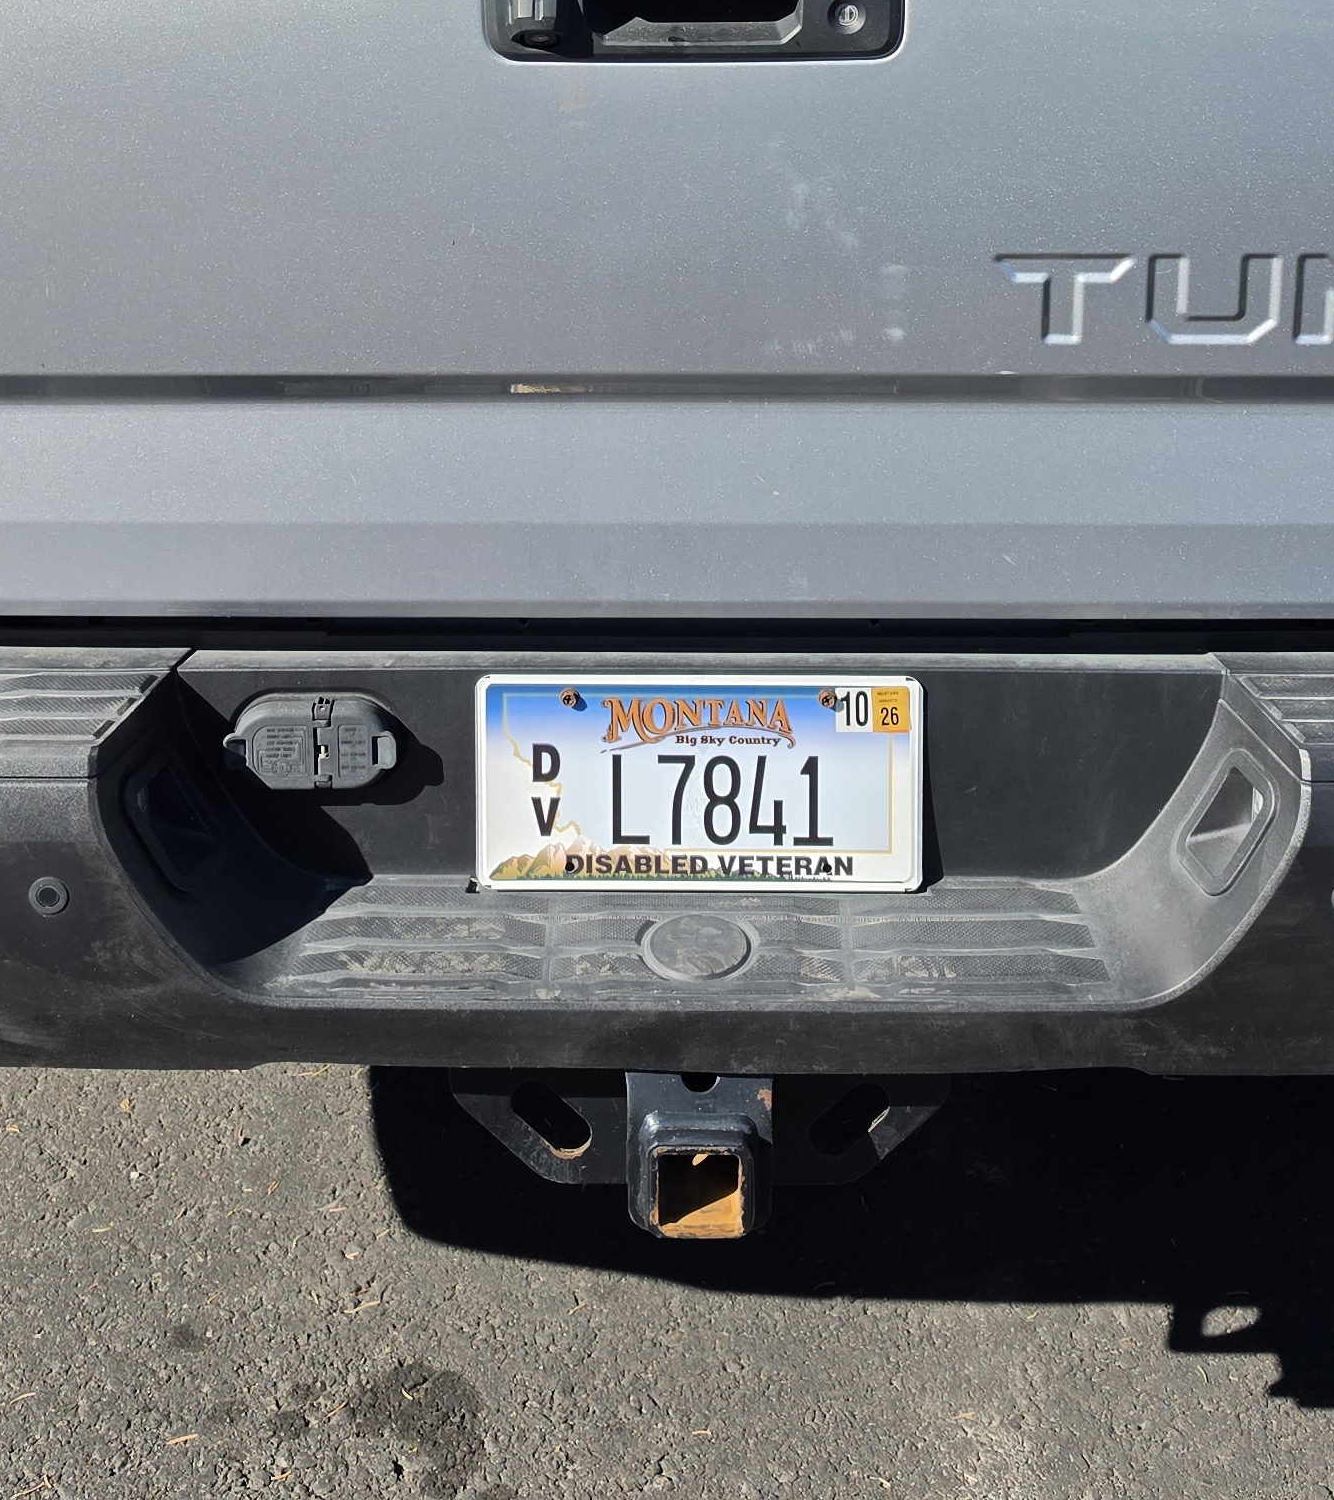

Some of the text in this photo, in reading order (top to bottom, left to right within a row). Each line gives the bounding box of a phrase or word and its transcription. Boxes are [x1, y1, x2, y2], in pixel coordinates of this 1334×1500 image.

[600, 697, 794, 744] MONTANA
[840, 690, 900, 727] 10 26
[675, 735, 782, 747] Big Sky Country
[611, 754, 834, 847] L7841
[566, 853, 854, 877] DISABLED VETERAN
